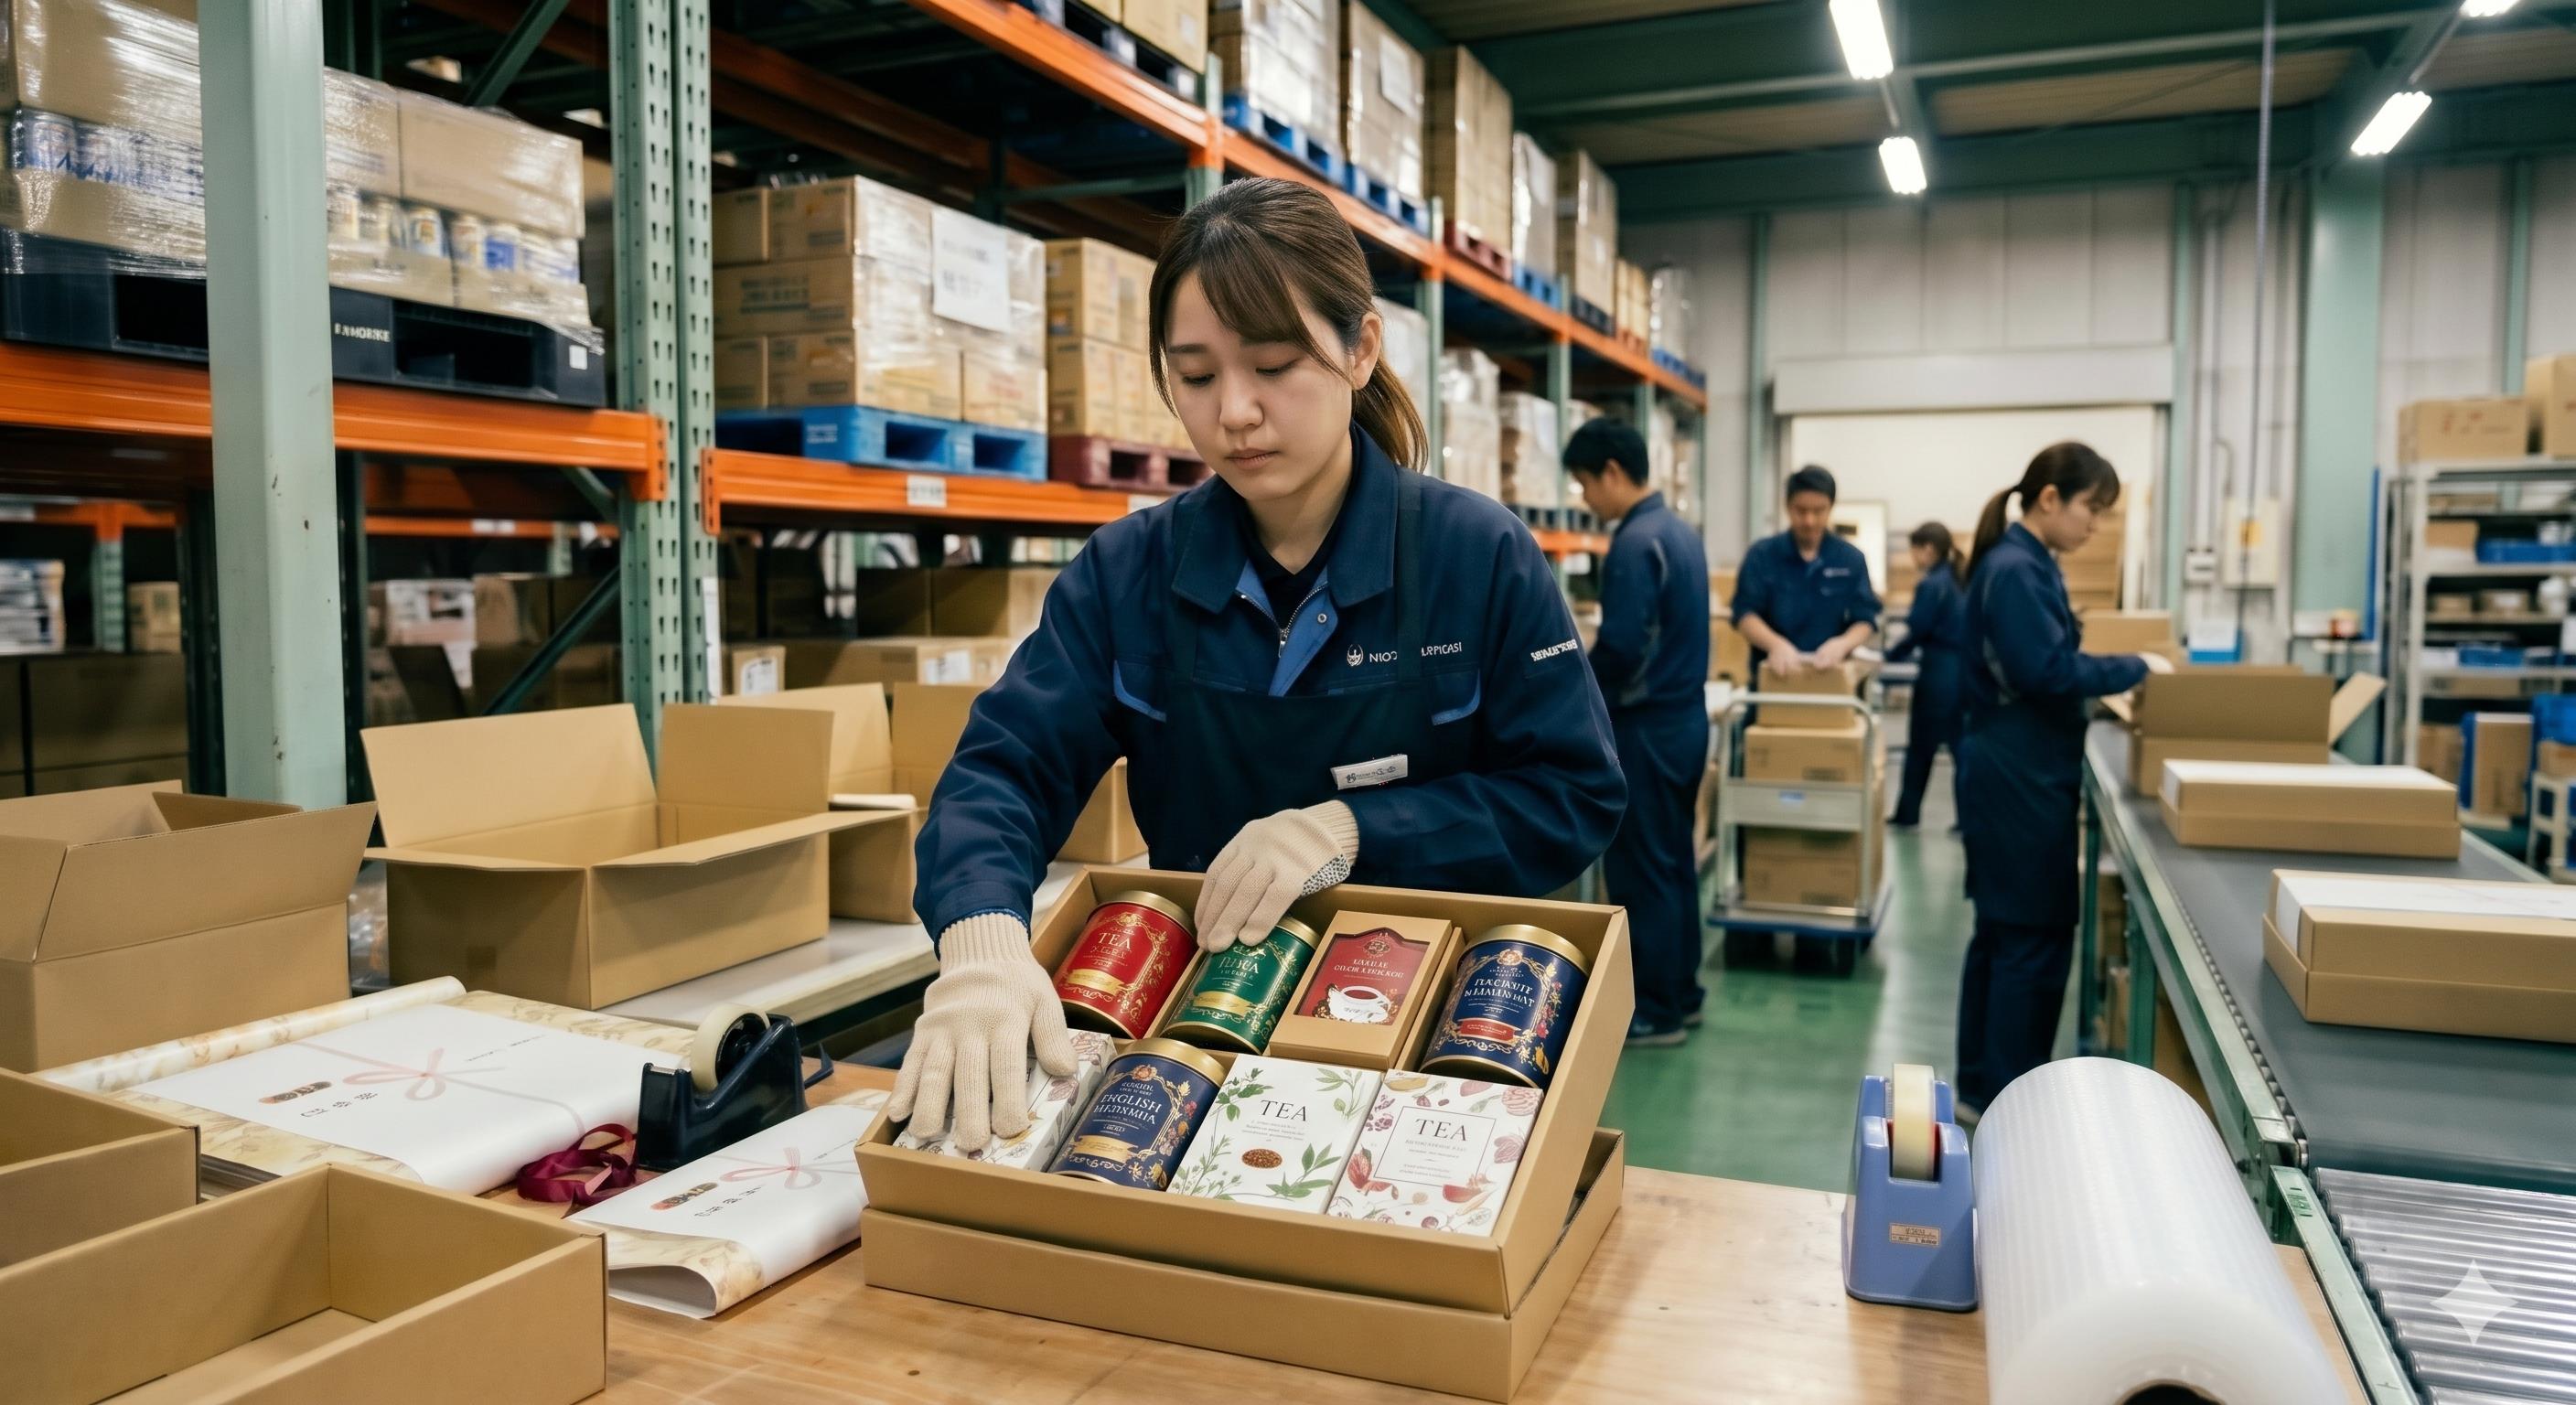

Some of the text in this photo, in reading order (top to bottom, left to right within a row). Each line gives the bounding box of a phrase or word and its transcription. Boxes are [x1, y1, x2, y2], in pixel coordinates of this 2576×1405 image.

[1099, 932, 1131, 949] TEA
[1261, 1099, 1306, 1121] TEA
[1415, 1118, 1466, 1142] TEA
